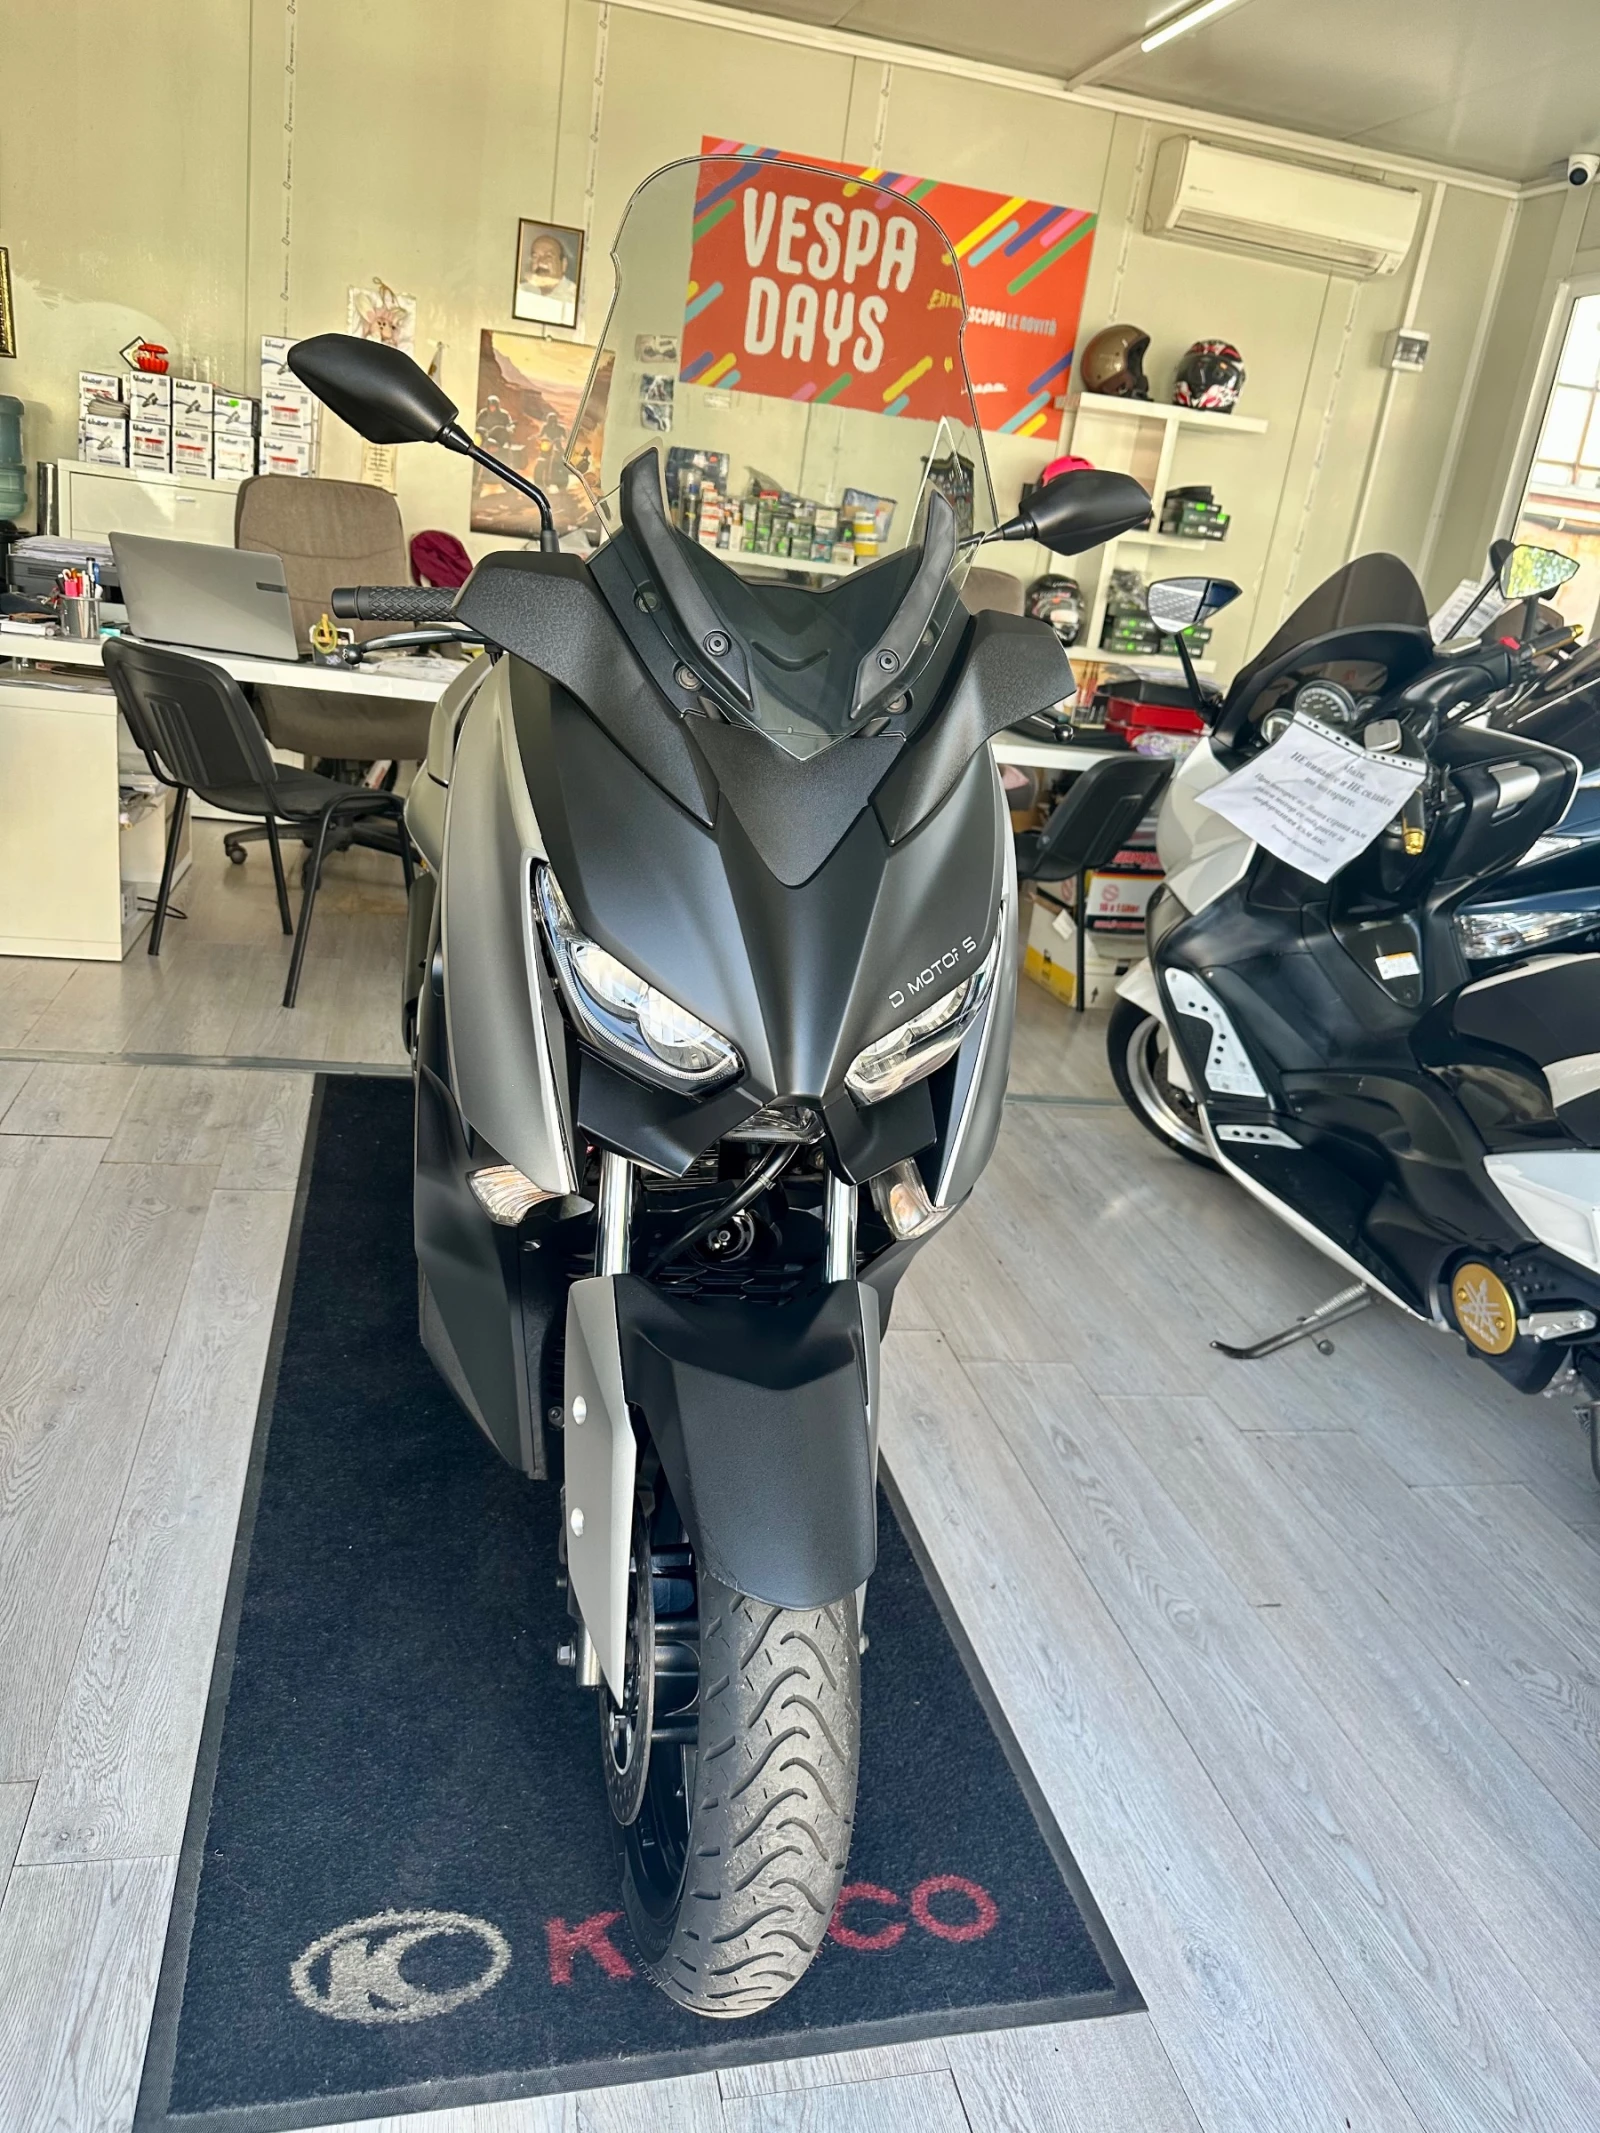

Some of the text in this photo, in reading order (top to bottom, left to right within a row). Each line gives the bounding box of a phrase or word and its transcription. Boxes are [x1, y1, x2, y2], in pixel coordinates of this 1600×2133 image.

[743, 187, 918, 293] VESPA
[744, 276, 889, 374] DAYS
[968, 305, 1006, 328] SCOPRI
[1006, 311, 1019, 331] LE
[1291, 751, 1307, 764] НЕ
[1348, 781, 1362, 793] НЕ
[545, 1874, 999, 1986] KCO
